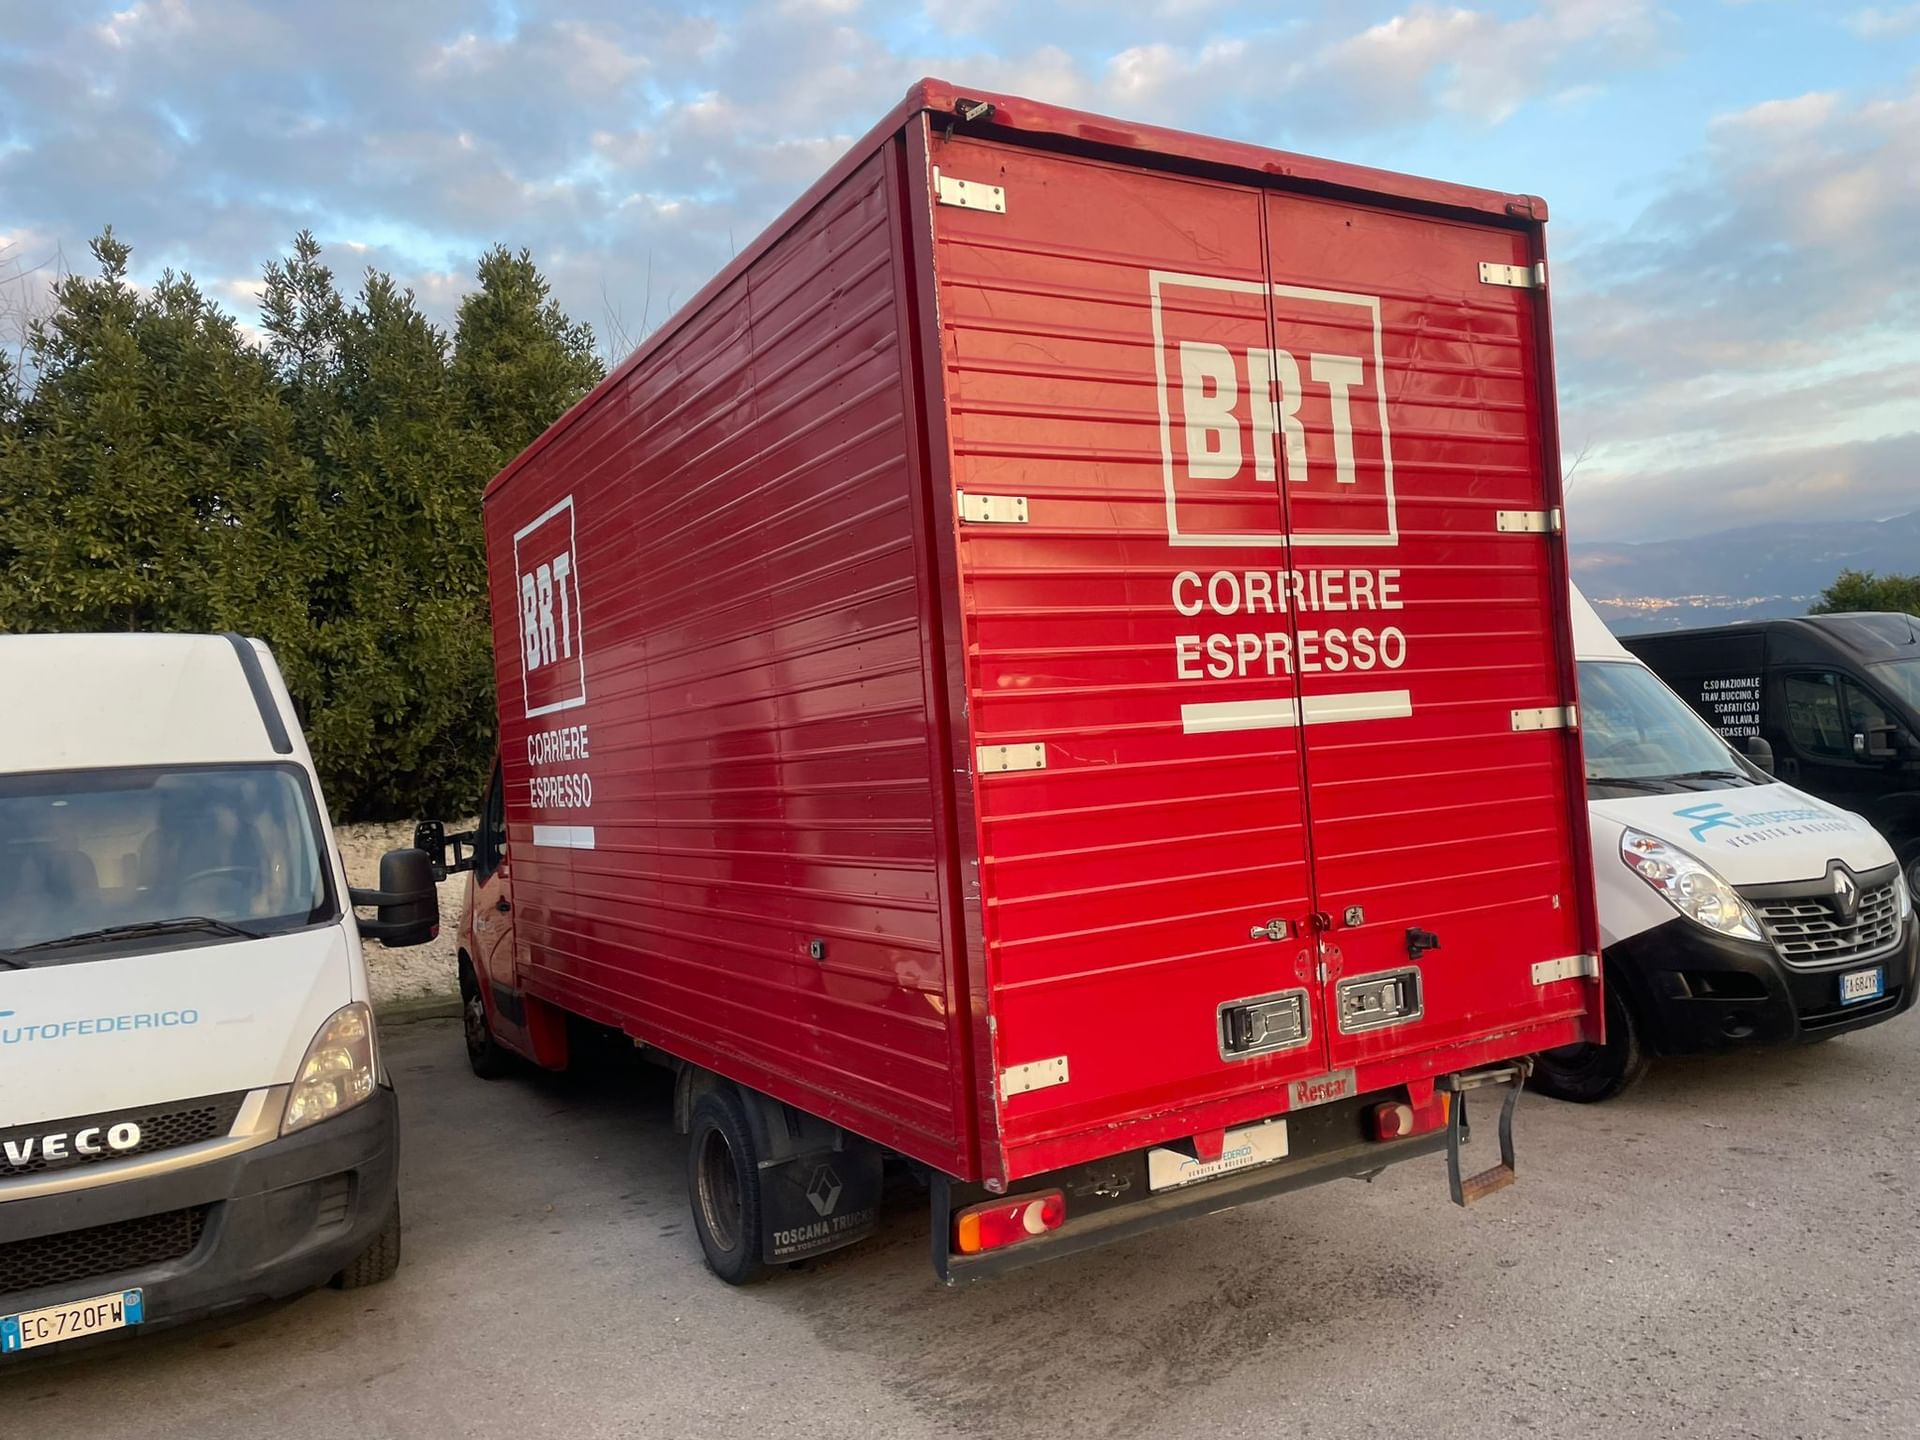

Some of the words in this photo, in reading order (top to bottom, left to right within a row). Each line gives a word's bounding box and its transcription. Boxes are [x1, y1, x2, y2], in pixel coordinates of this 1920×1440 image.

[1178, 341, 1364, 484] BRT
[522, 551, 571, 671] BRT
[1171, 569, 1404, 617] CORRIERE
[1174, 626, 1407, 681] ESPRESSO
[1714, 702, 1742, 713] SCAFATI
[527, 725, 590, 767] CORRIERE
[529, 772, 592, 809] ESPRESSO
[1, 1009, 199, 1044] UTOFEDERICO
[2, 1121, 142, 1167] VECO
[1222, 1146, 1252, 1161] EDERICO
[773, 1220, 830, 1246] TOSCANA
